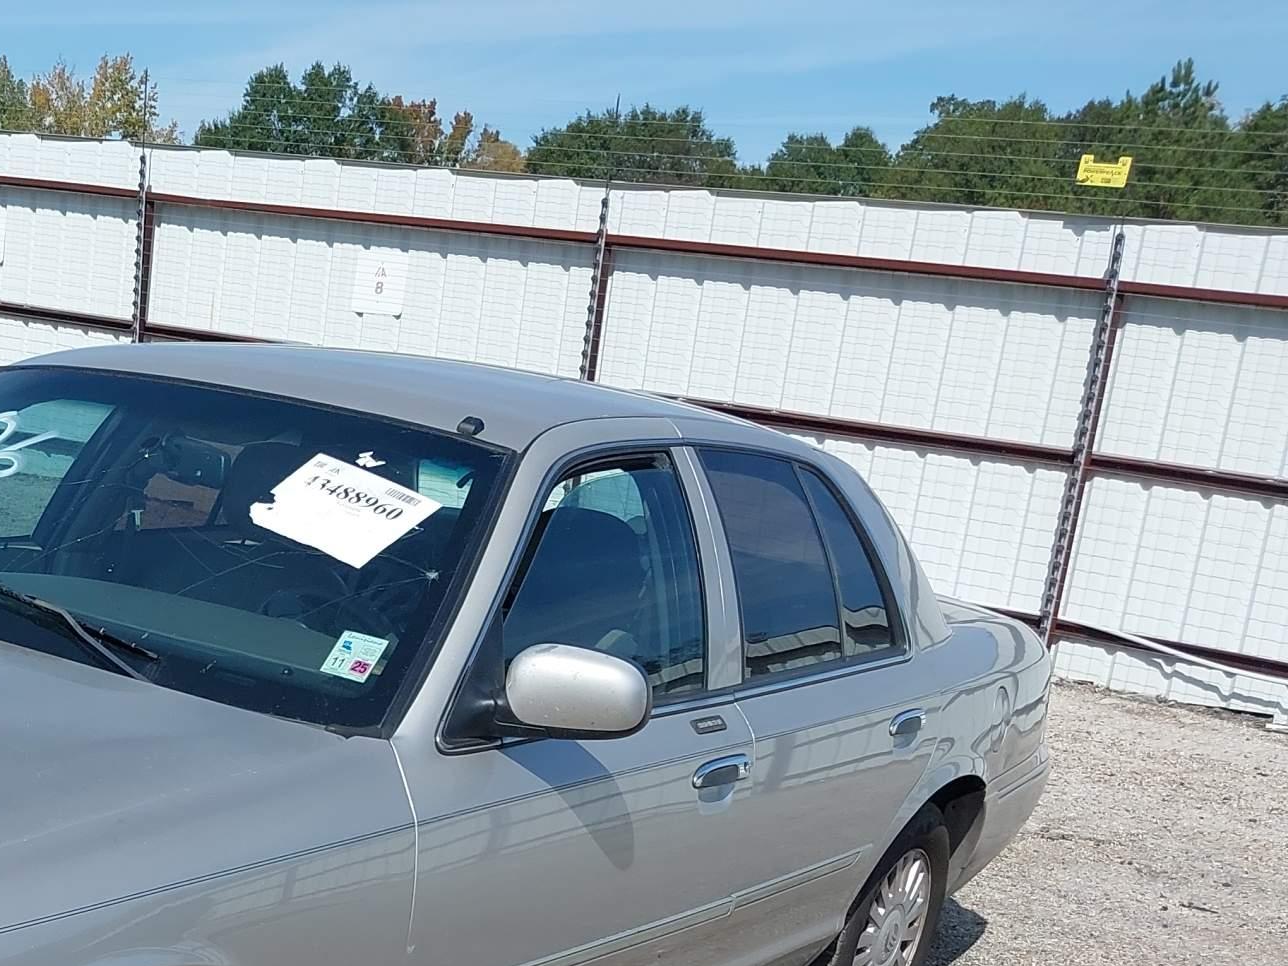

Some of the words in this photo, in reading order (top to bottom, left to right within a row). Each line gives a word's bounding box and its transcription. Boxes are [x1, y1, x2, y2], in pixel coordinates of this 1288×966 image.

[374, 281, 384, 295] 8
[331, 656, 346, 668] 11
[351, 660, 369, 674] 25
